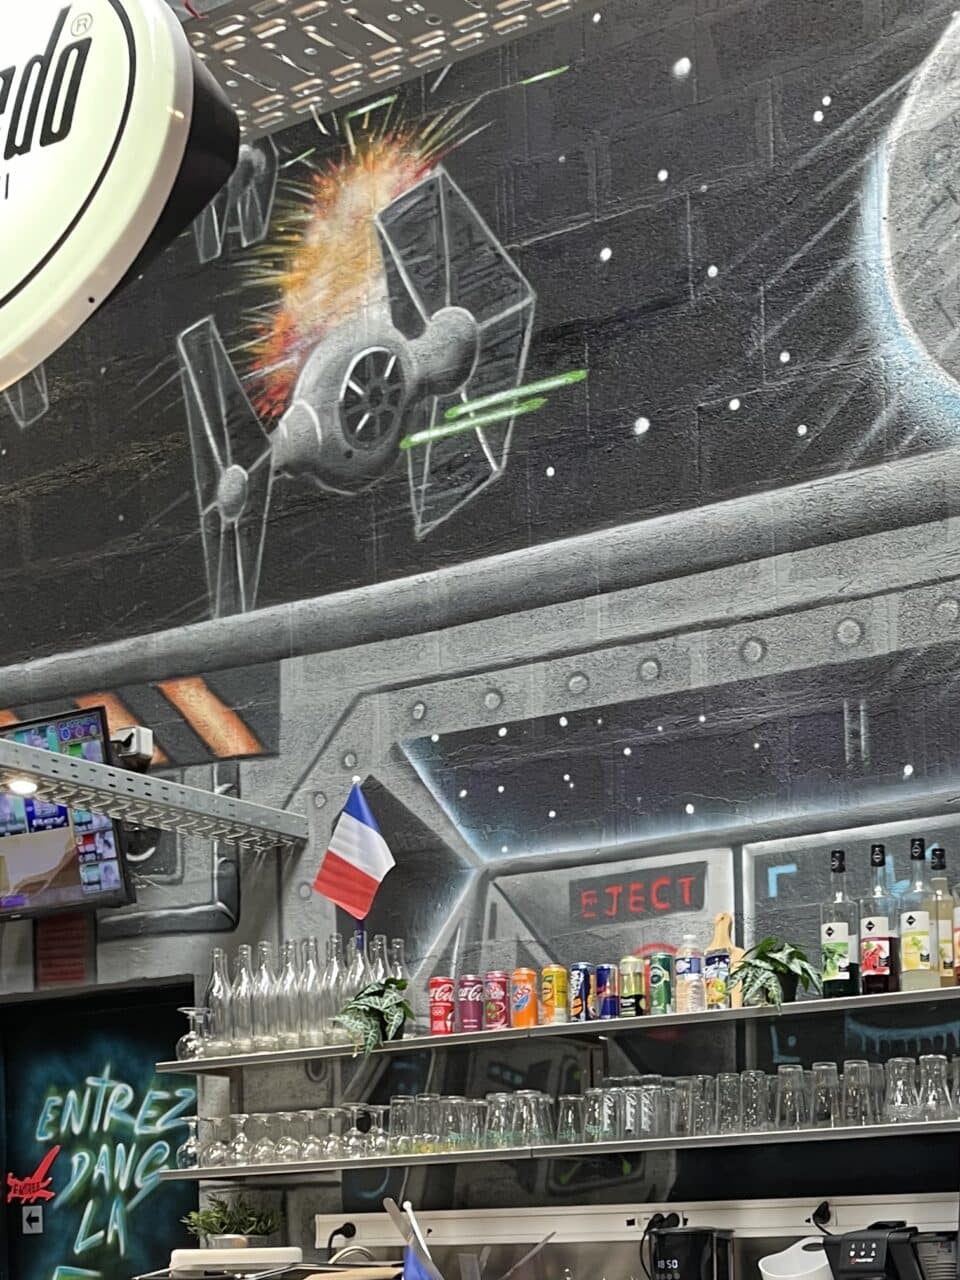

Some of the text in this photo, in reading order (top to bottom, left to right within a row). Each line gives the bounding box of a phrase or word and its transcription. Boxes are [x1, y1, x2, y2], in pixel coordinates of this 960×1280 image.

[580, 875, 697, 918] EJECT
[36, 1063, 197, 1142] ENTREZ
[73, 1195, 126, 1256] LA
